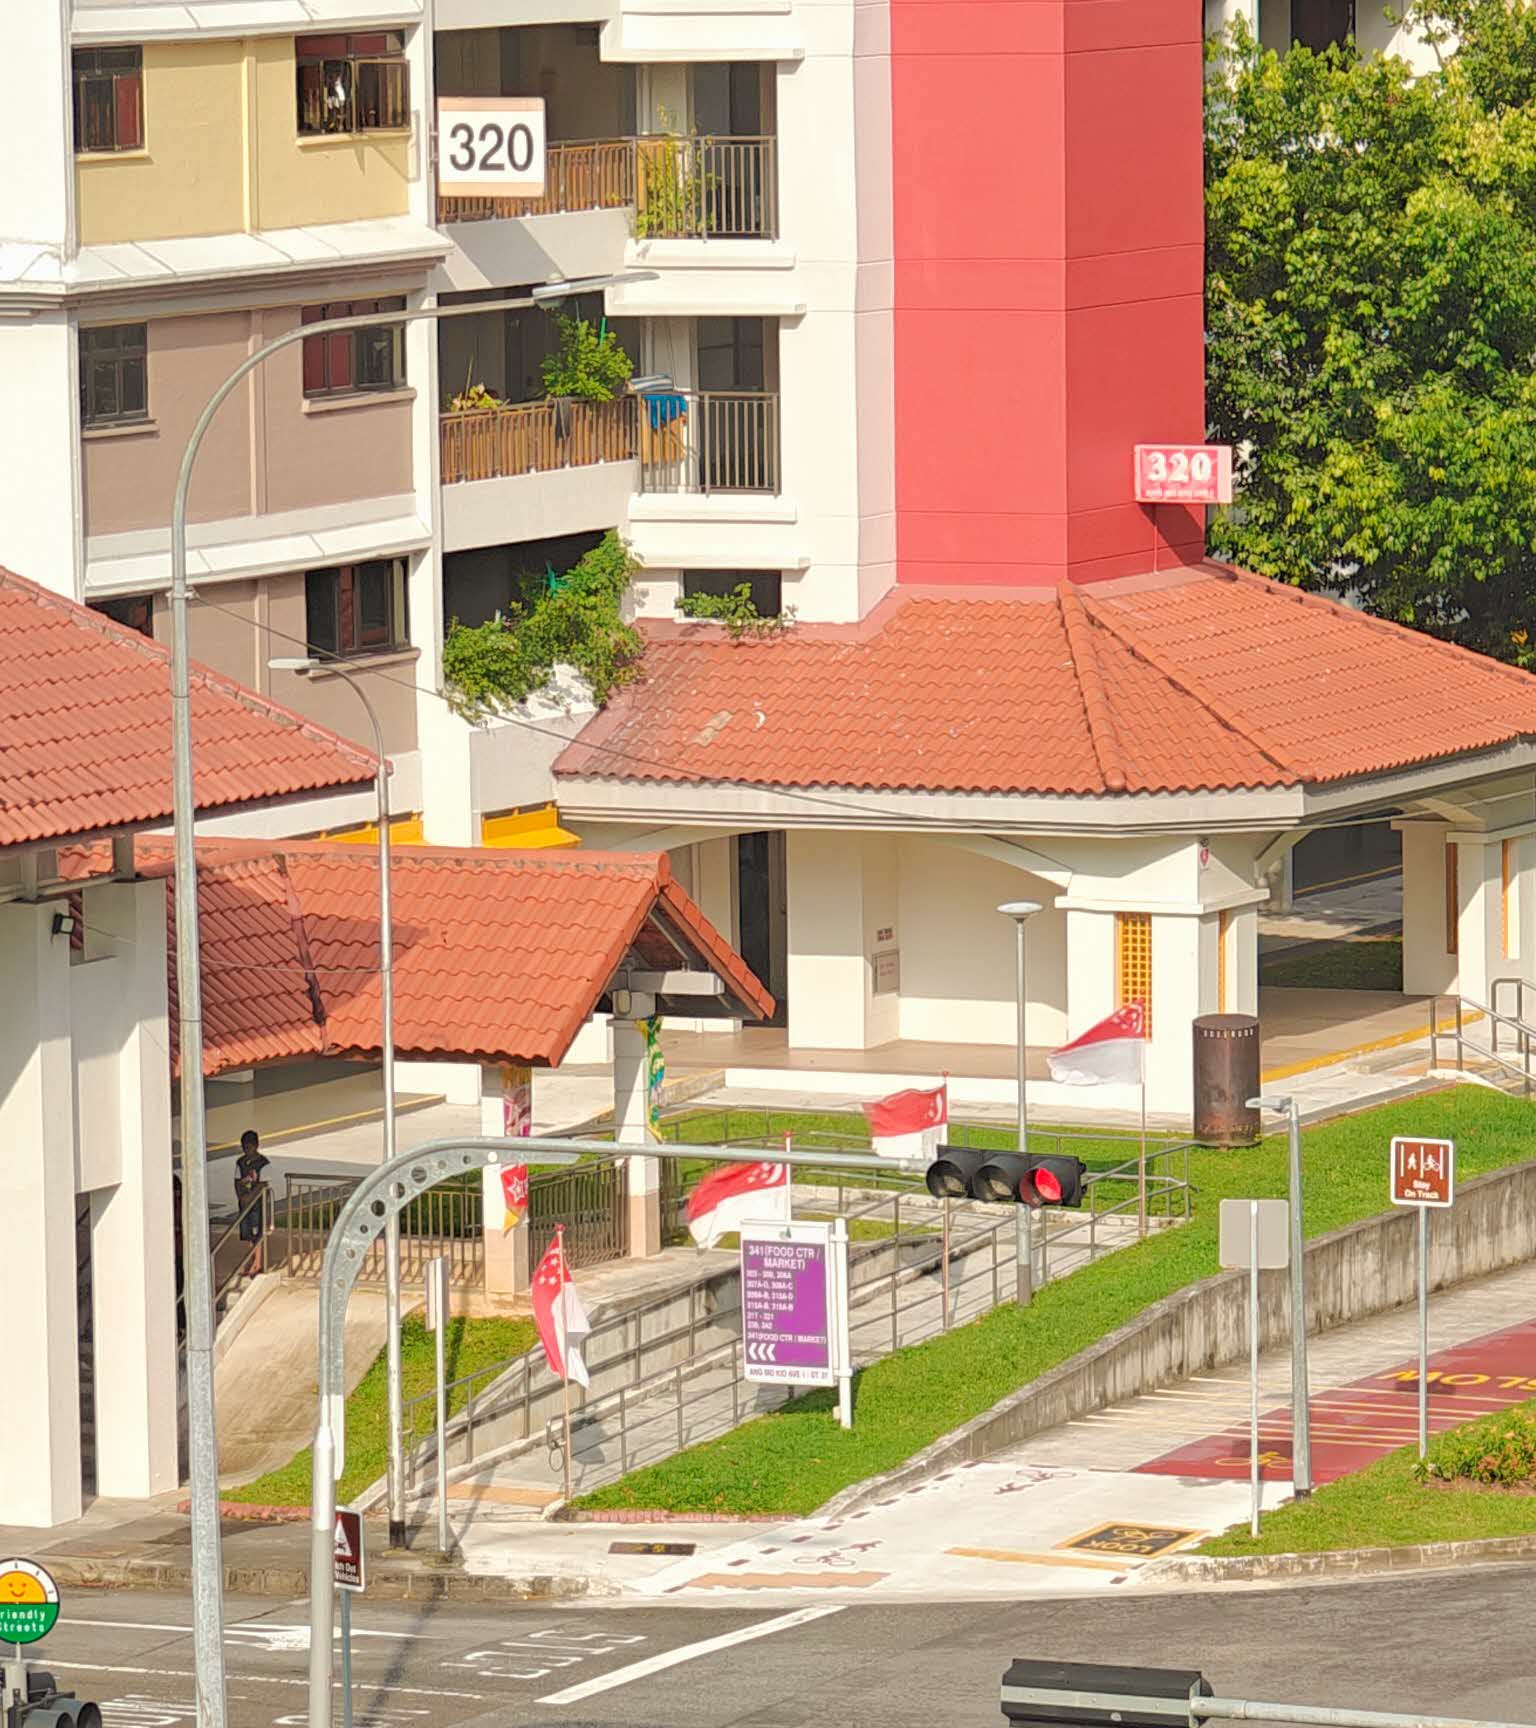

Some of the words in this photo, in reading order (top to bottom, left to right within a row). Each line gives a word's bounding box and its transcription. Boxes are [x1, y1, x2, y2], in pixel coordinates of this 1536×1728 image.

[450, 123, 534, 171] 320
[1146, 452, 1212, 482] 320
[1413, 1180, 1431, 1190] Stay
[1404, 1189, 1416, 1197] On
[1417, 1190, 1440, 1199] Track
[796, 1247, 815, 1258] CTR
[764, 1257, 806, 1271] MARKET)
